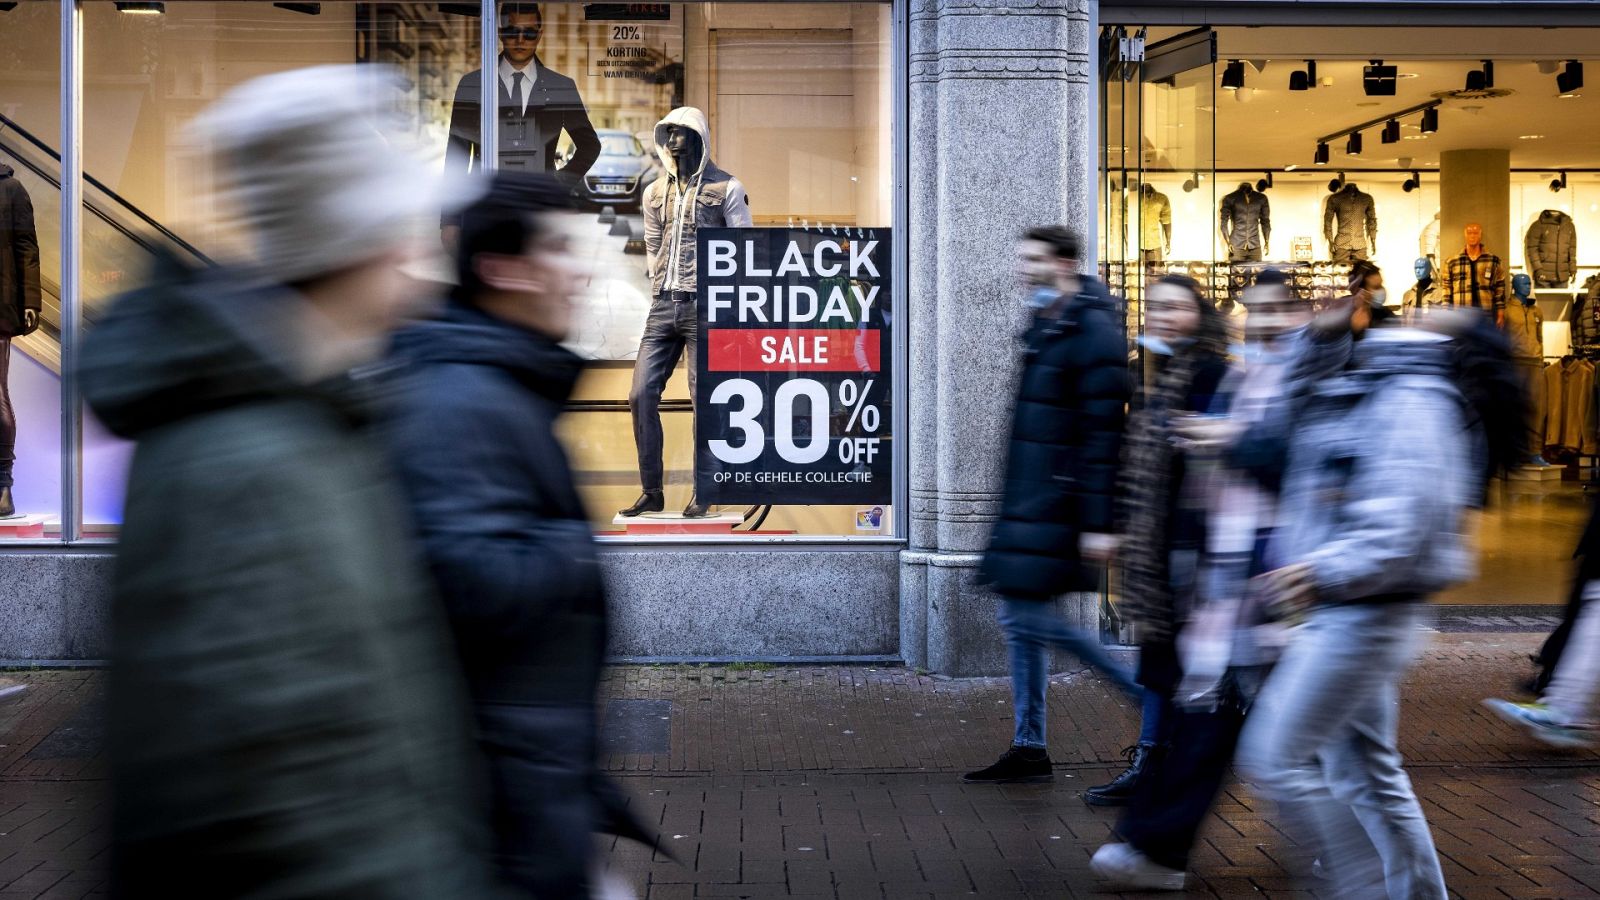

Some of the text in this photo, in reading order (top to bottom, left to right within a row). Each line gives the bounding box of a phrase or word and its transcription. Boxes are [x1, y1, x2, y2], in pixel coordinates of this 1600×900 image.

[613, 26, 640, 40] 20%
[607, 47, 647, 57] KORTING
[708, 240, 881, 277] BLACK
[708, 286, 881, 322] FRIDAY
[761, 336, 828, 364] SALE
[839, 437, 880, 464] OFF
[713, 472, 872, 483] OP DE GEHELE COLLECTIE
